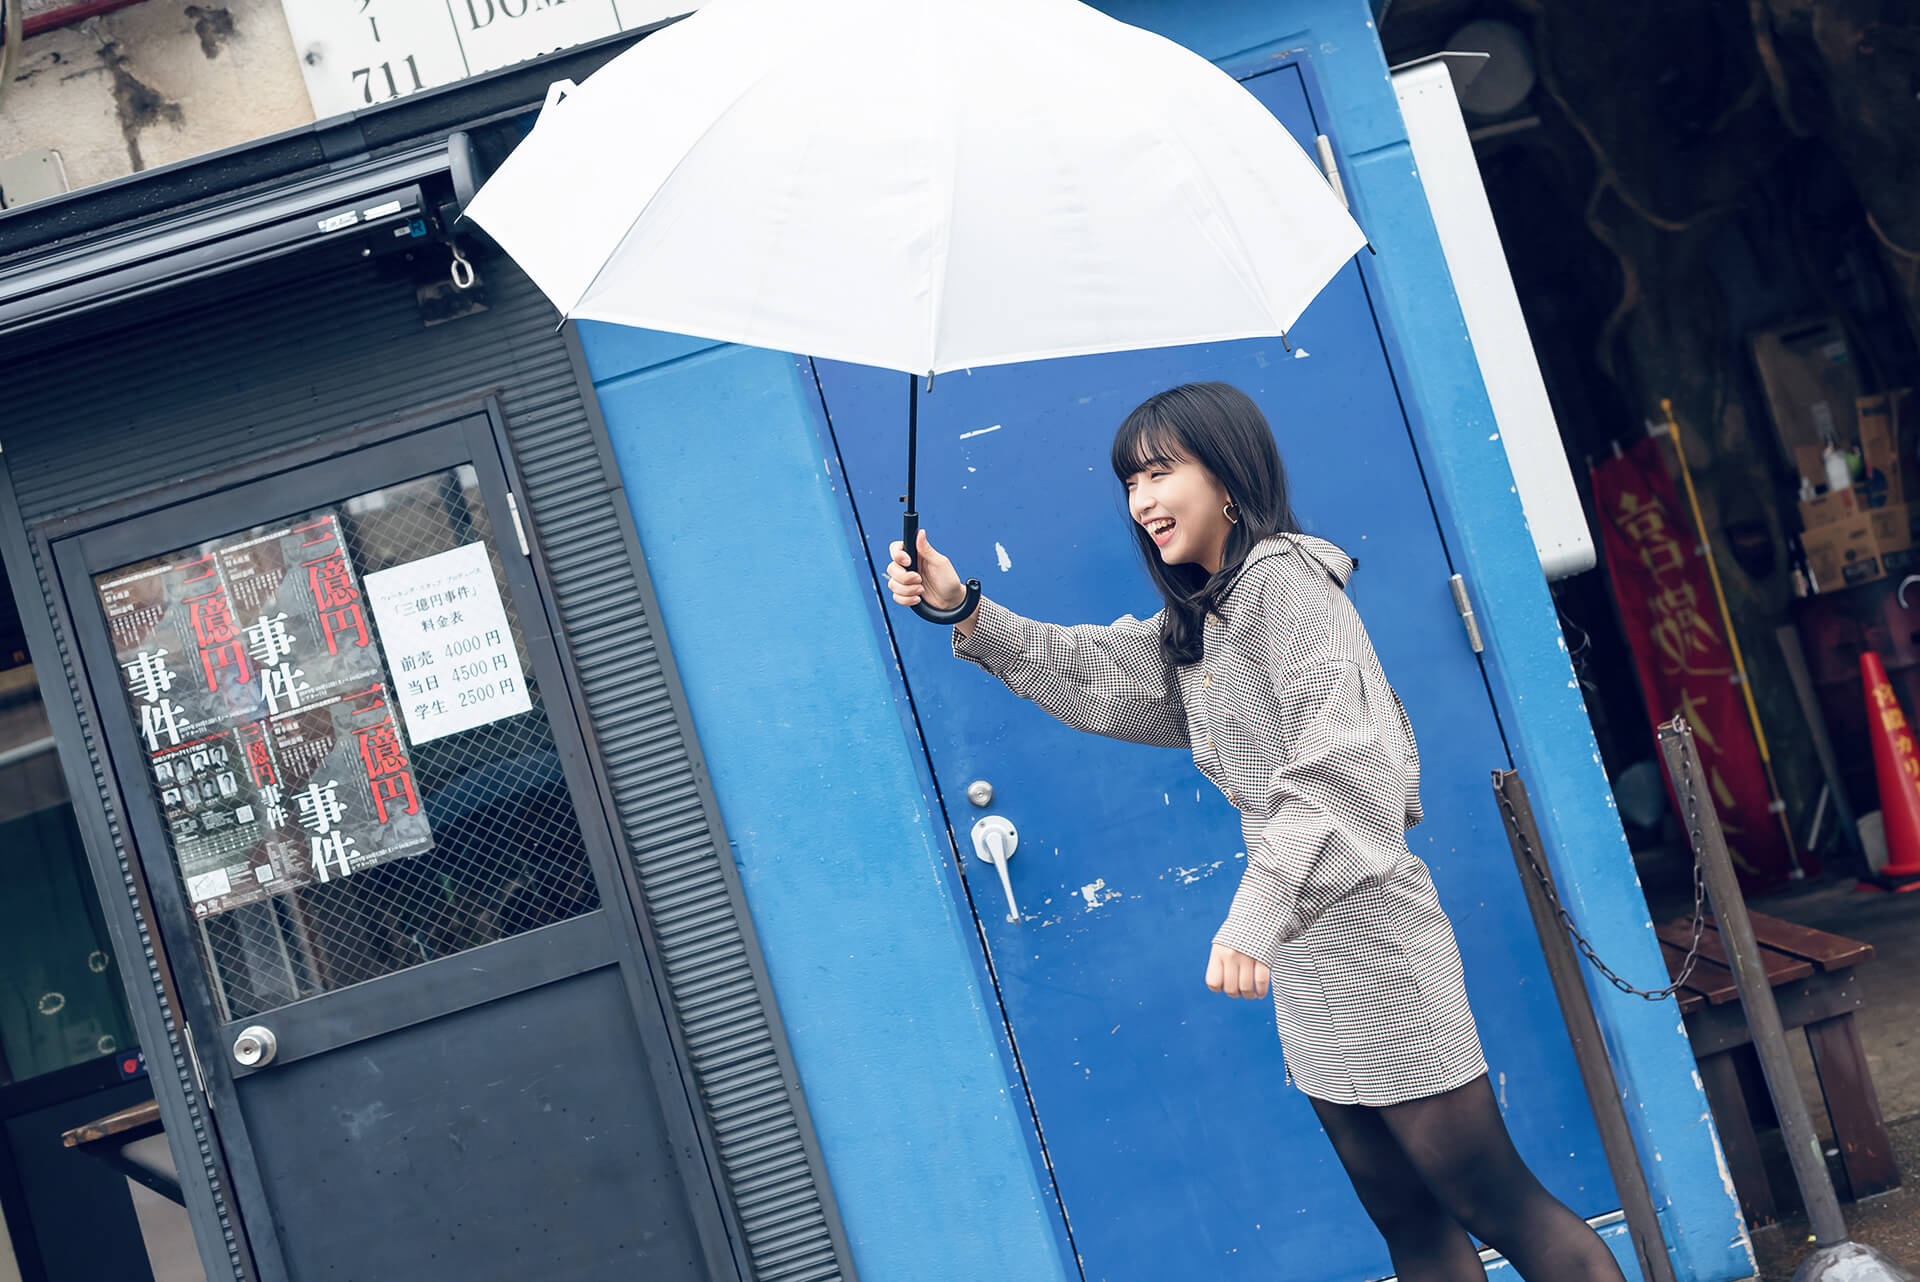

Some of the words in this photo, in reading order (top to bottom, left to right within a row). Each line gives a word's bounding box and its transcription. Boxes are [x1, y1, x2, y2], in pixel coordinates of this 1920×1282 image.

[352, 55, 425, 104] 711
[292, 514, 370, 656] 三億円
[173, 553, 252, 692] 三億円
[401, 651, 434, 672] 前売
[445, 635, 481, 659] 4000
[421, 611, 465, 633] 料金表
[240, 611, 311, 715] 事件
[408, 675, 439, 696] 当日
[452, 660, 488, 682] 4500
[121, 648, 190, 752] 事件
[414, 699, 448, 720] 学生
[458, 683, 495, 707] 2500
[239, 721, 277, 789] 三億円
[342, 682, 421, 824] 三億円
[257, 783, 289, 831] 事件
[290, 779, 362, 884] 事件
